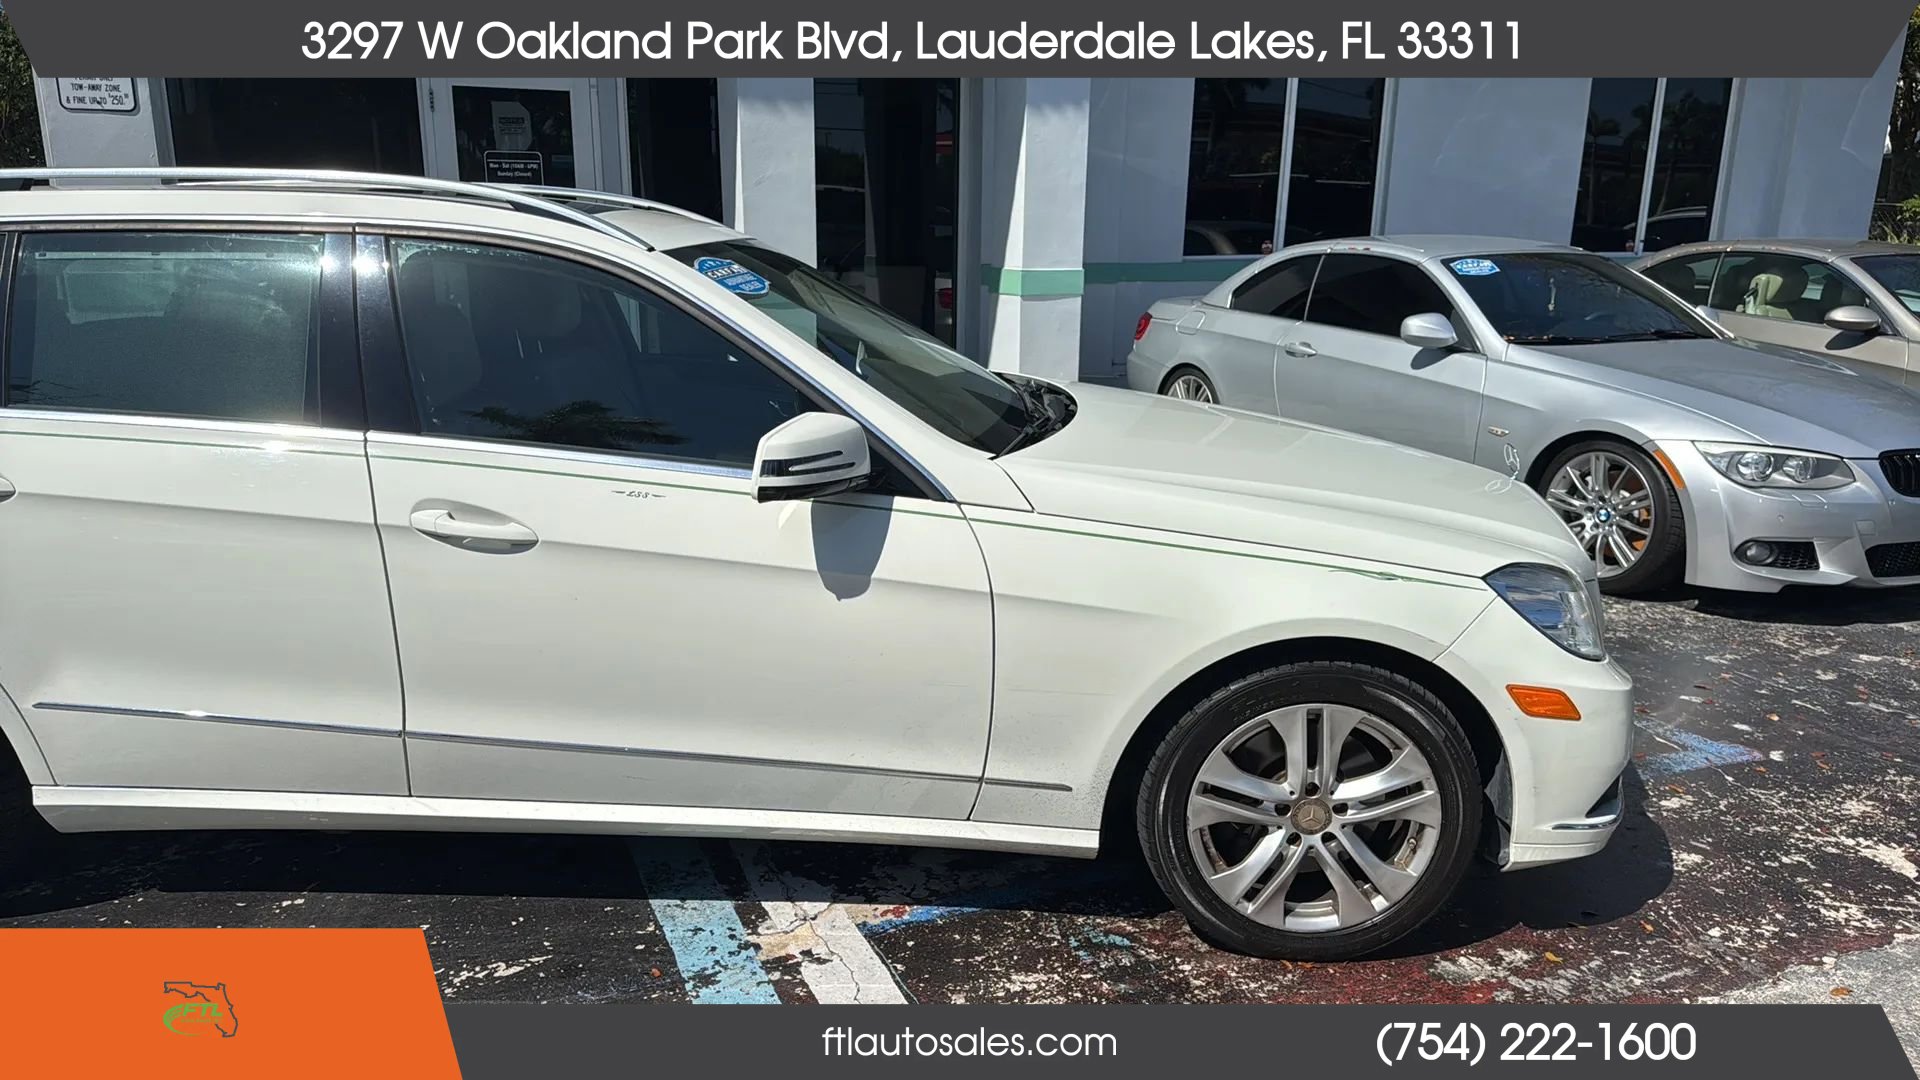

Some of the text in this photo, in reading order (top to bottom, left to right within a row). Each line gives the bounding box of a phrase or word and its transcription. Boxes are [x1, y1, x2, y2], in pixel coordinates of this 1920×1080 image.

[71, 83, 122, 93] TOW-AWAY ZONE
[72, 96, 88, 105] FINE
